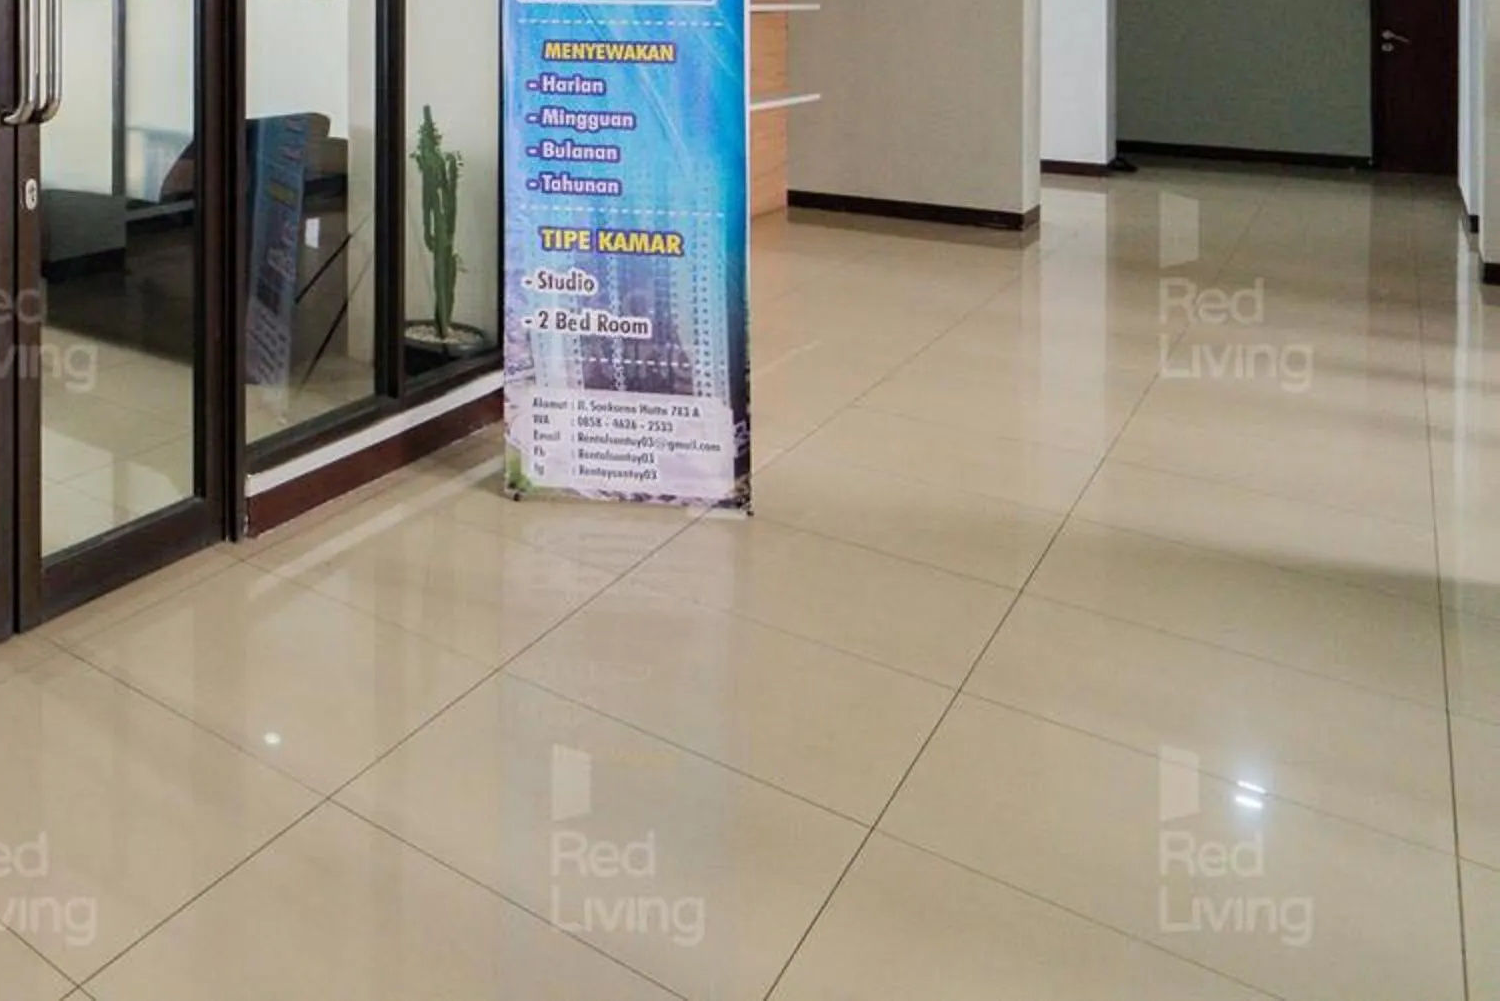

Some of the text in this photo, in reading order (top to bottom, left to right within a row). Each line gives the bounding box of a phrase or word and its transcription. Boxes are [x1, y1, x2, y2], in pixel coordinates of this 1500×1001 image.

[544, 42, 675, 62] MENYEWAKAN
[542, 75, 604, 94] Harian
[542, 108, 635, 130] Mingguan
[542, 142, 619, 161] Bulanan
[541, 174, 620, 194] Tahunan
[542, 229, 683, 254] TIPE KAMAR
[537, 270, 596, 292] Studio
[538, 311, 549, 329] 2
[555, 311, 591, 331] Bed
[598, 314, 649, 334] Room
[533, 415, 550, 424] WA
[533, 430, 561, 441] Email
